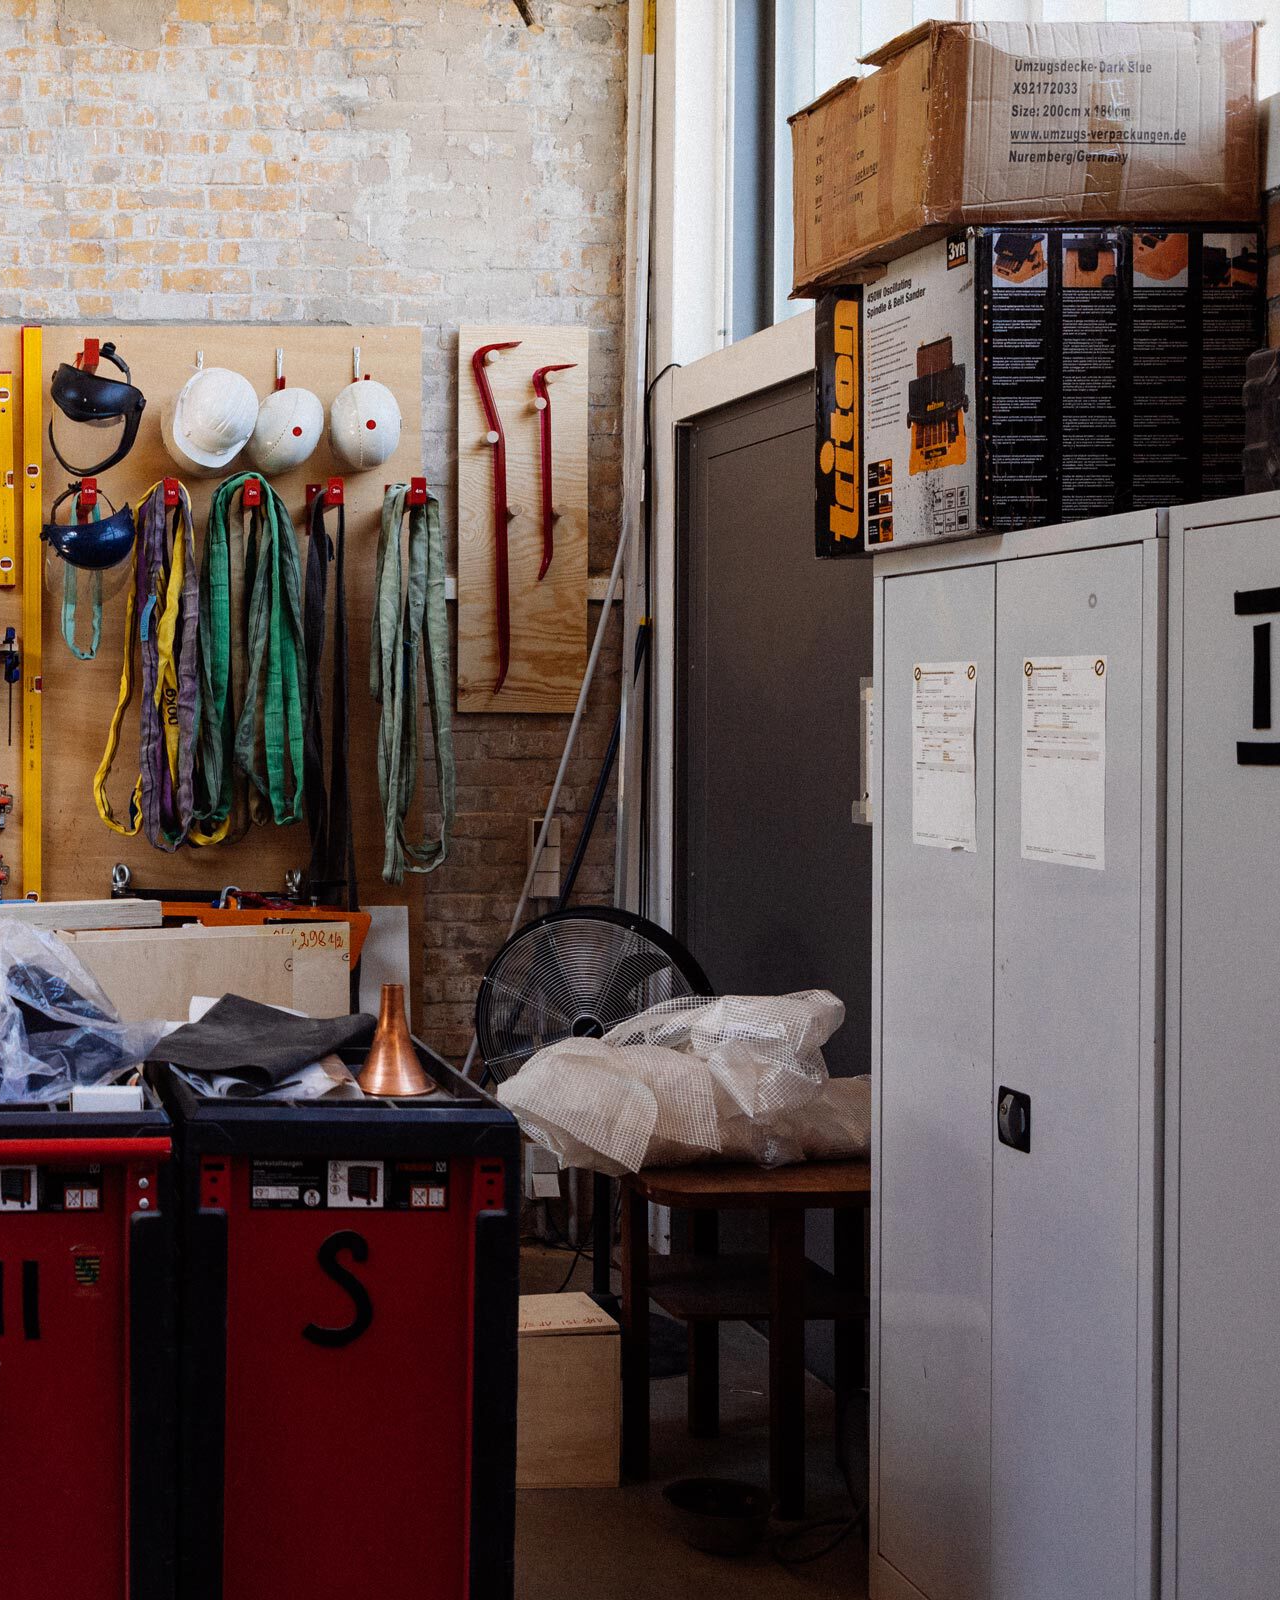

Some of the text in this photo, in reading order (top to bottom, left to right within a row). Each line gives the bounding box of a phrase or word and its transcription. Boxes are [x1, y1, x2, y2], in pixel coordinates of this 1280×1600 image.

[1099, 60, 1124, 73] Dark
[1128, 61, 1152, 73] Blue
[1012, 82, 1078, 95] X92172033
[1011, 105, 1040, 117] Size:
[1042, 105, 1081, 117] 200cm
[1084, 108, 1090, 117] x
[1010, 128, 1187, 142] www.umzugs-verpackungen.de
[1008, 150, 1129, 165] Nuremberg/Germany
[948, 241, 966, 261] 3YR
[882, 278, 912, 296] Oscillating
[866, 301, 887, 319] Spindle
[893, 296, 905, 308] Belt
[905, 287, 926, 303] Sander
[819, 299, 860, 542] triton
[301, 1229, 374, 1348] S
